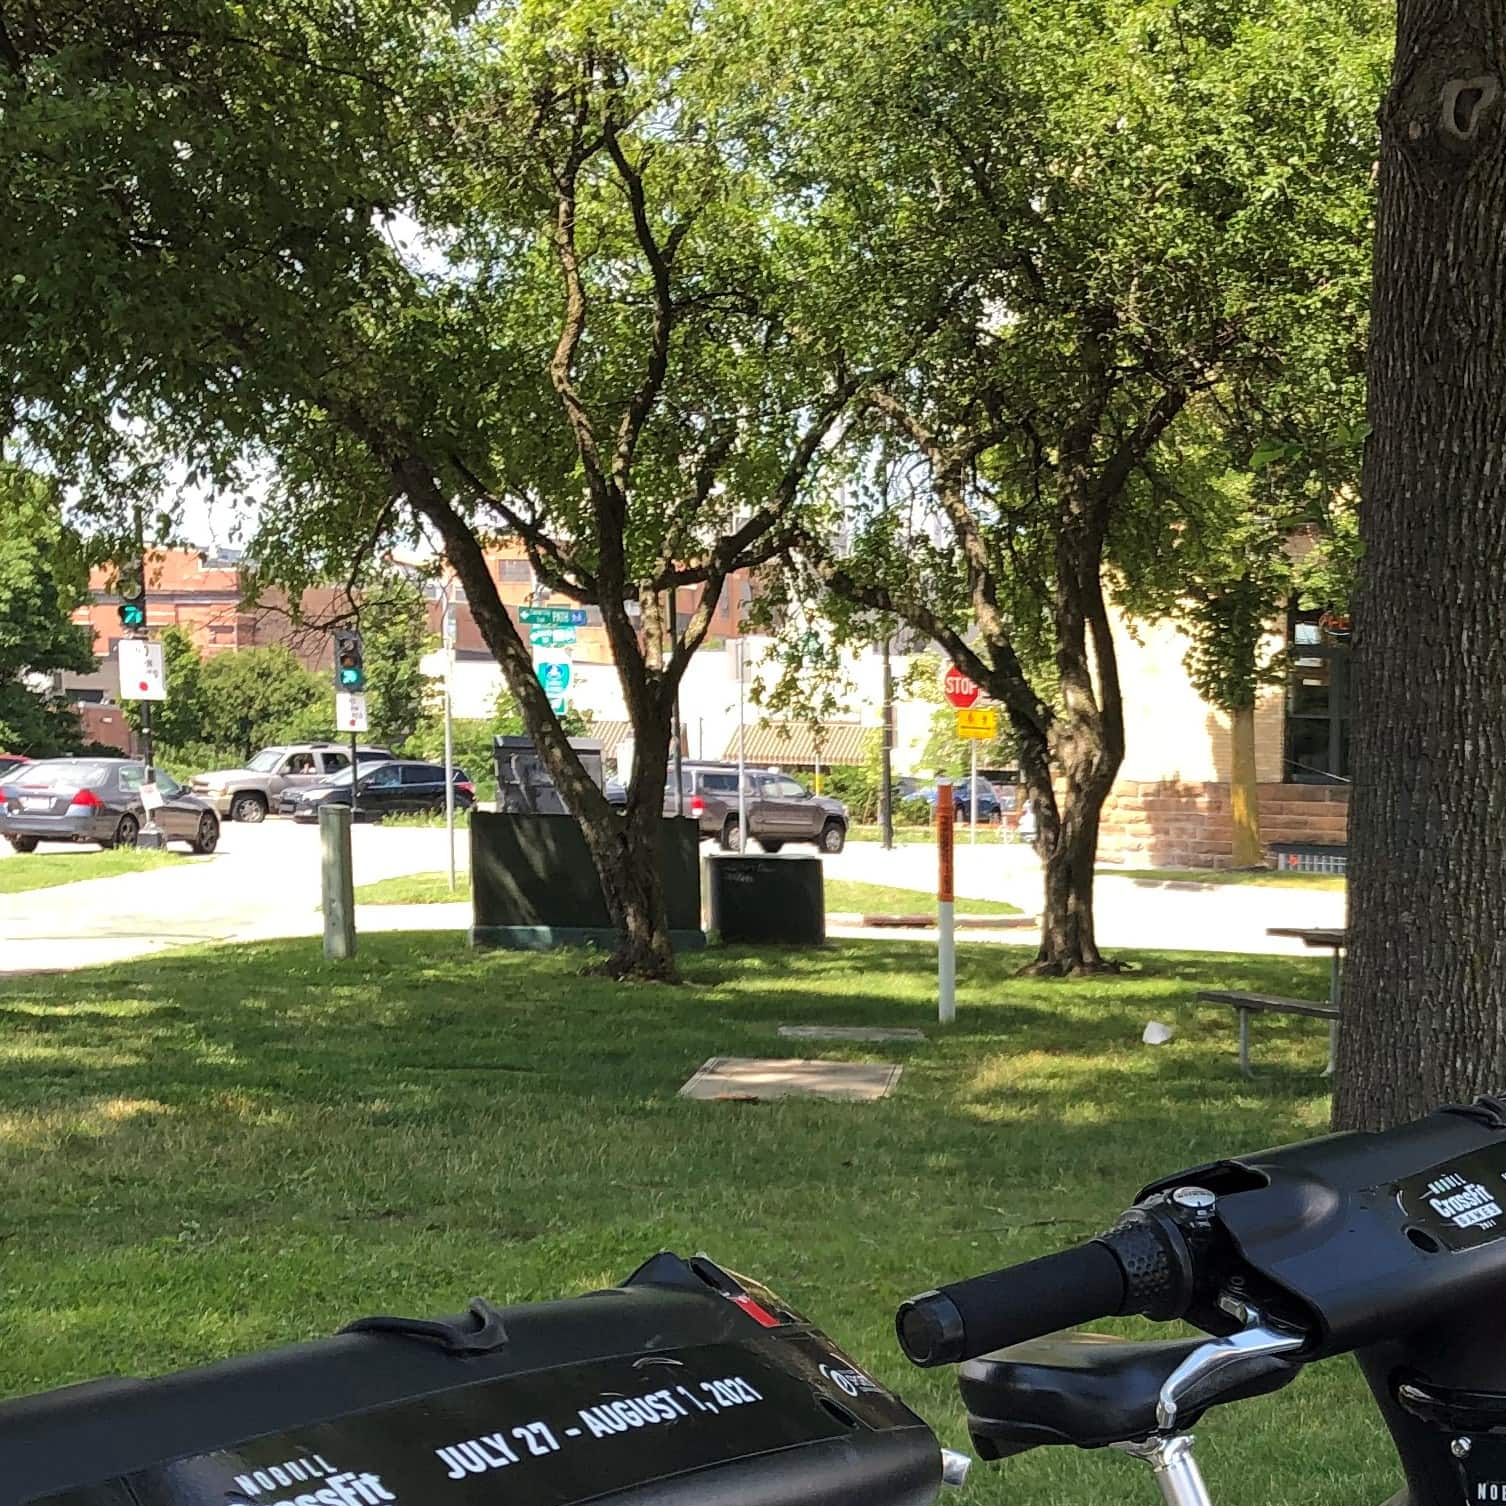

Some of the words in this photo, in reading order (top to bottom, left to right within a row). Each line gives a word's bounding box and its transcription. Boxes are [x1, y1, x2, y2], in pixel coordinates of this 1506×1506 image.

[946, 677, 977, 695] STOP
[1429, 1183, 1495, 1218] CrossFit
[435, 1433, 520, 1480] JULY
[512, 1421, 561, 1456] 27
[578, 1389, 689, 1438] AUGUST
[677, 1386, 719, 1415] 1,
[700, 1377, 763, 1408] 2021
[233, 1454, 338, 1497] NOBULL
